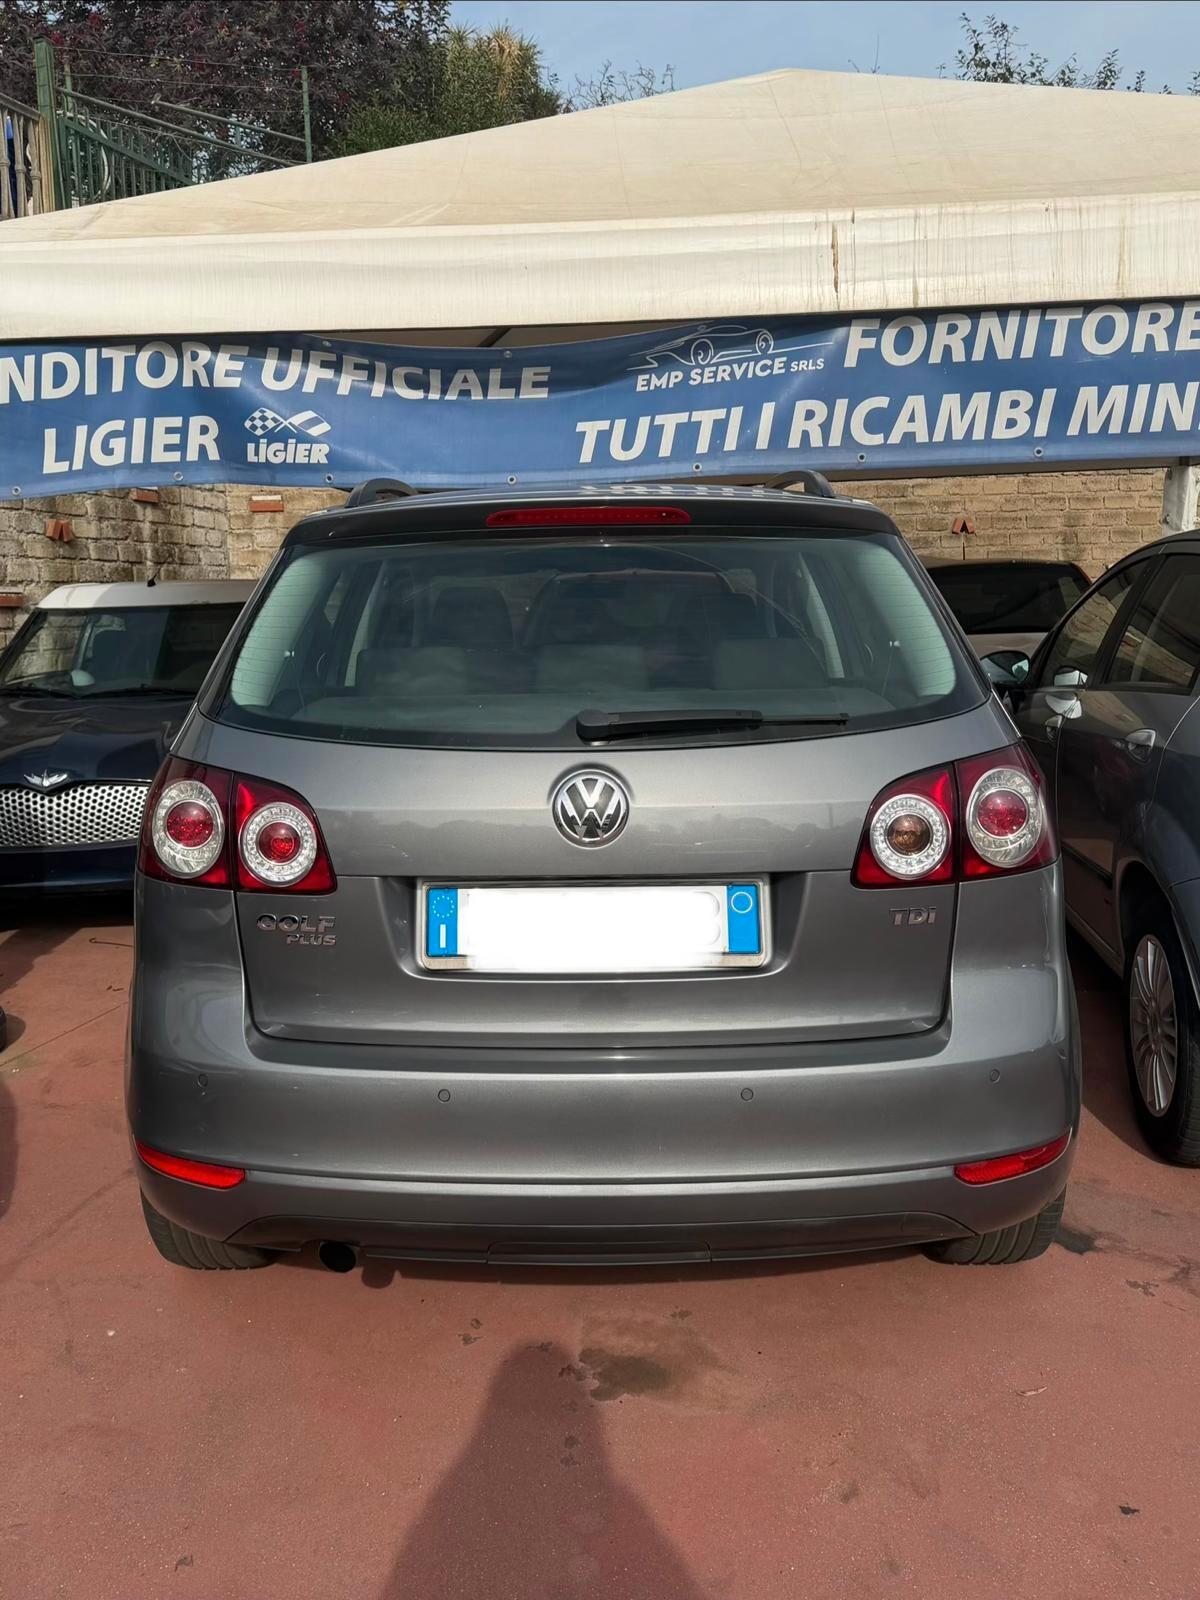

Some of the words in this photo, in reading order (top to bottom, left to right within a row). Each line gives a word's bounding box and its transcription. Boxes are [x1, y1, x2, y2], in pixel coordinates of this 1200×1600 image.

[843, 301, 1200, 368] FORNITORE
[0, 340, 249, 403] NDITORE
[261, 346, 551, 400] UFFICIALE
[636, 371, 683, 392] EMP
[688, 356, 787, 386] SERVICE
[790, 358, 825, 372] SRLS
[43, 415, 220, 474] LIGIER
[575, 406, 744, 464] TUTTI
[755, 402, 776, 449] I
[787, 388, 1057, 449] RICAMBI
[1066, 381, 1200, 436] MIN
[257, 913, 336, 933] GOLF
[286, 933, 336, 946] PLUS
